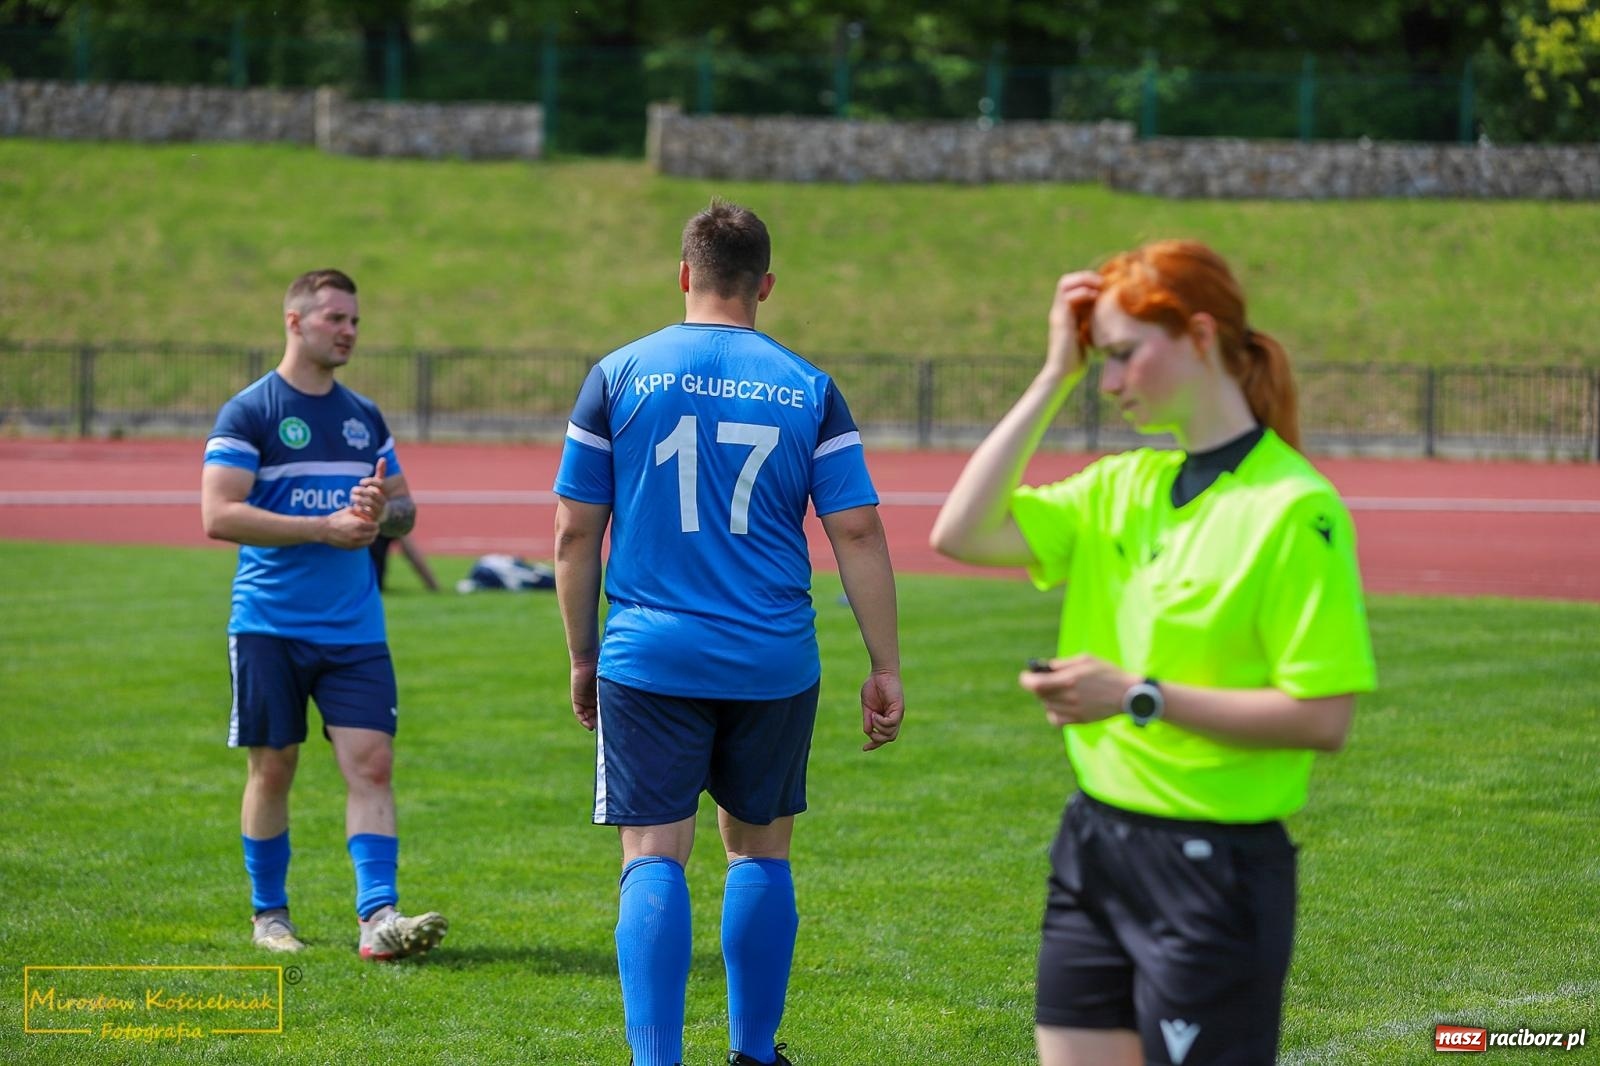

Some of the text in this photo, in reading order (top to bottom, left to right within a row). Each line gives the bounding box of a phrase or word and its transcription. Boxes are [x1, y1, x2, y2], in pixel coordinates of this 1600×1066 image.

[635, 373, 805, 408] KPP GŁUBCZYCE
[655, 415, 780, 535] 17
[290, 488, 349, 509] POLIC
